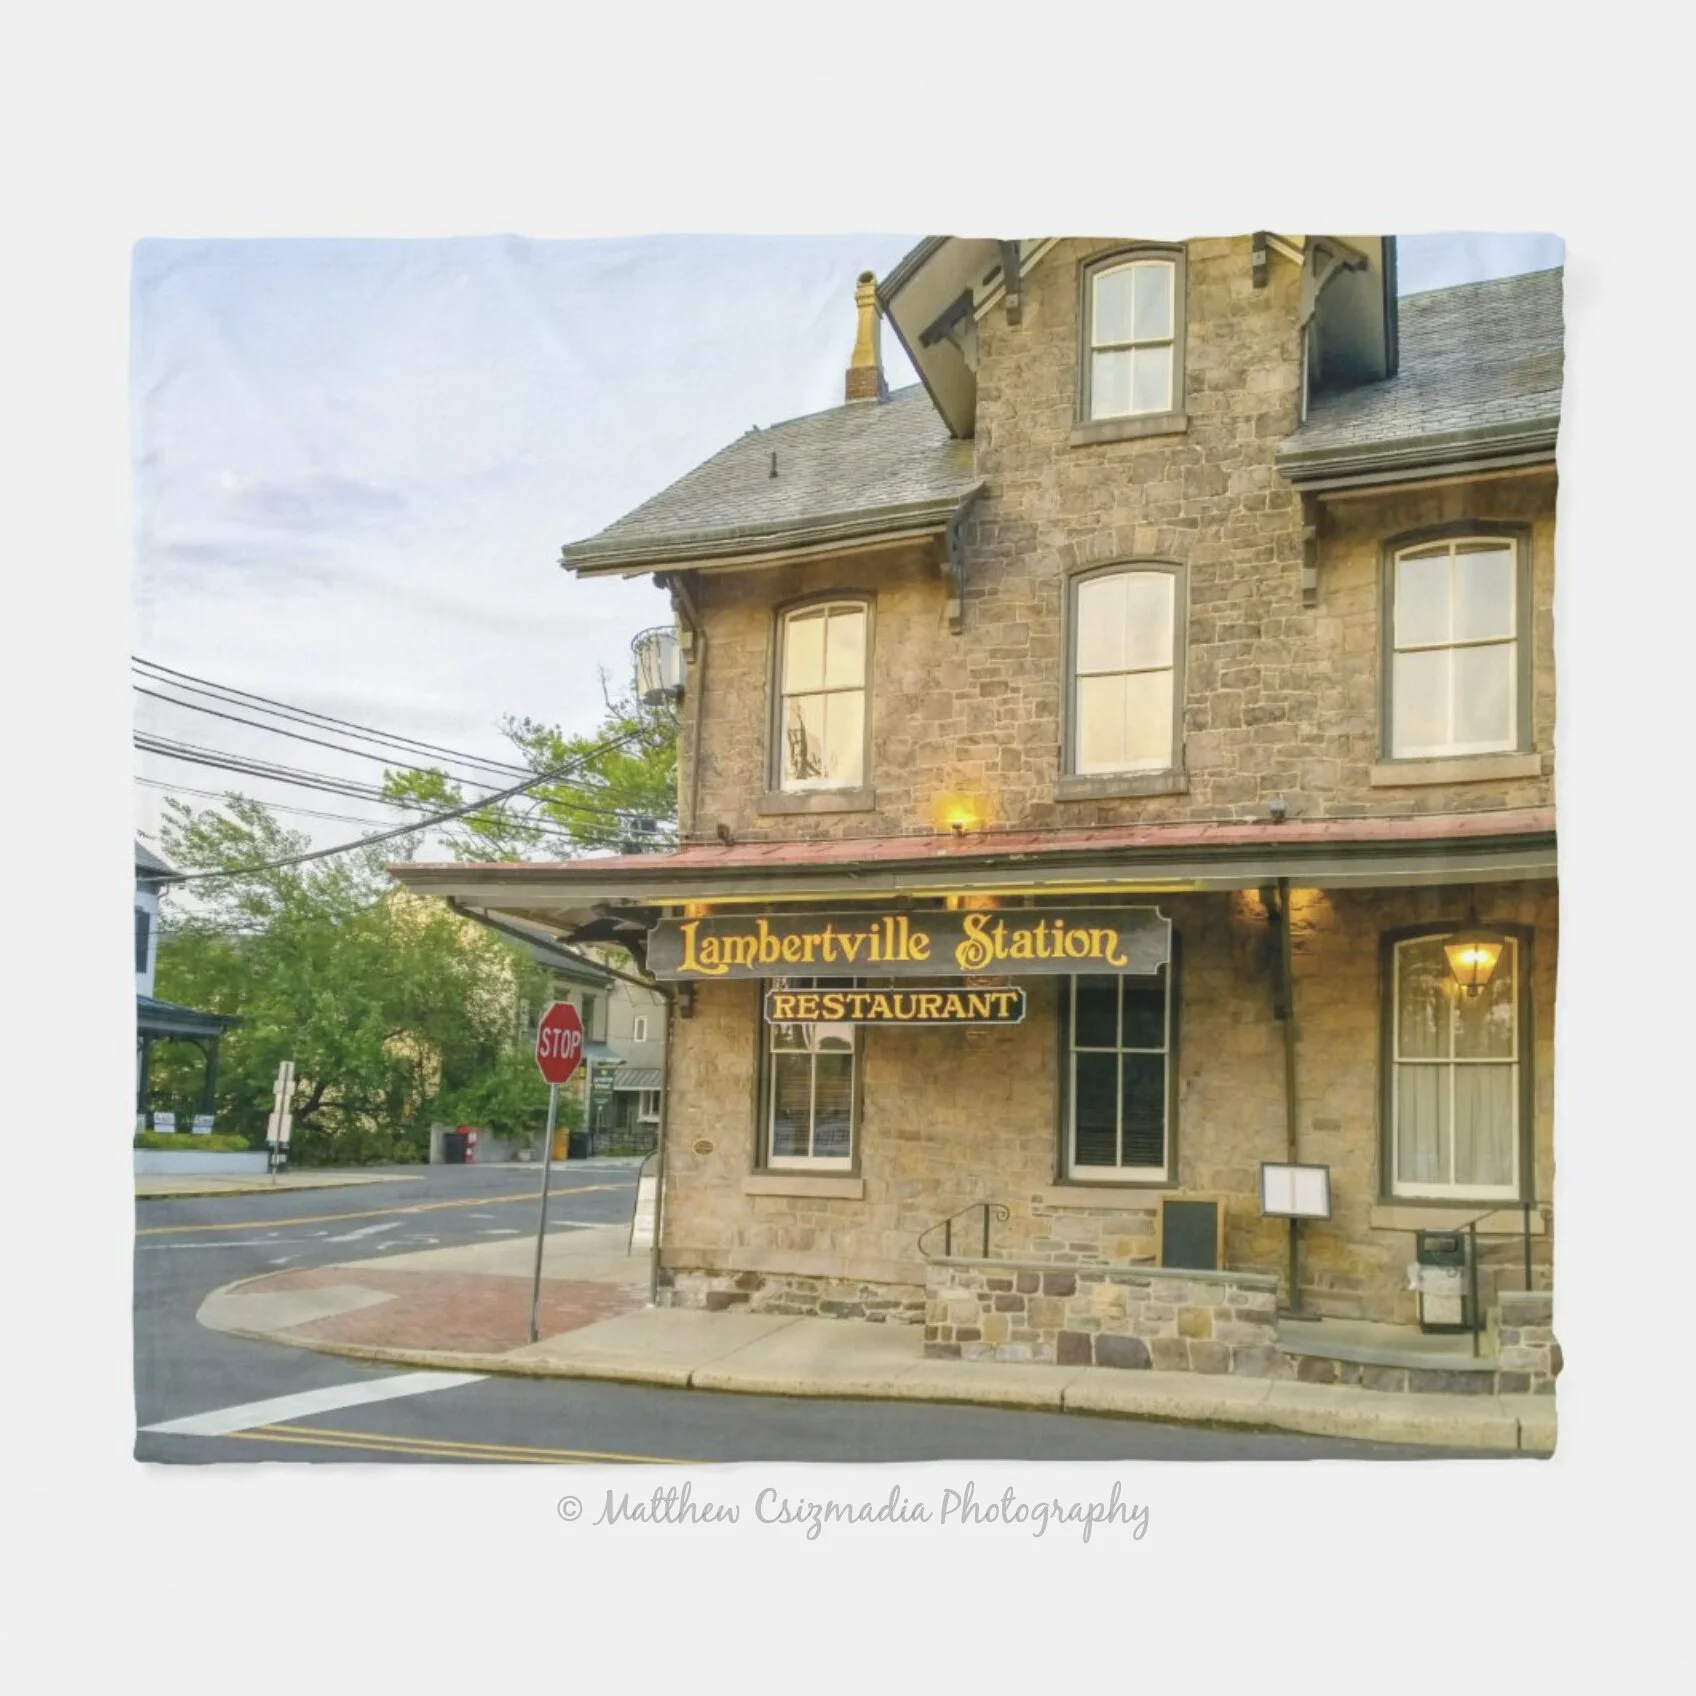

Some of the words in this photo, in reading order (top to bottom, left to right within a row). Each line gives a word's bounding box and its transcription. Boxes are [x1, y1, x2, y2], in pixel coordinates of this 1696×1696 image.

[677, 916, 931, 974] Lambertville
[954, 913, 1128, 971] Station
[772, 992, 1019, 1020] RESTAURANT
[540, 1027, 581, 1059] STOP
